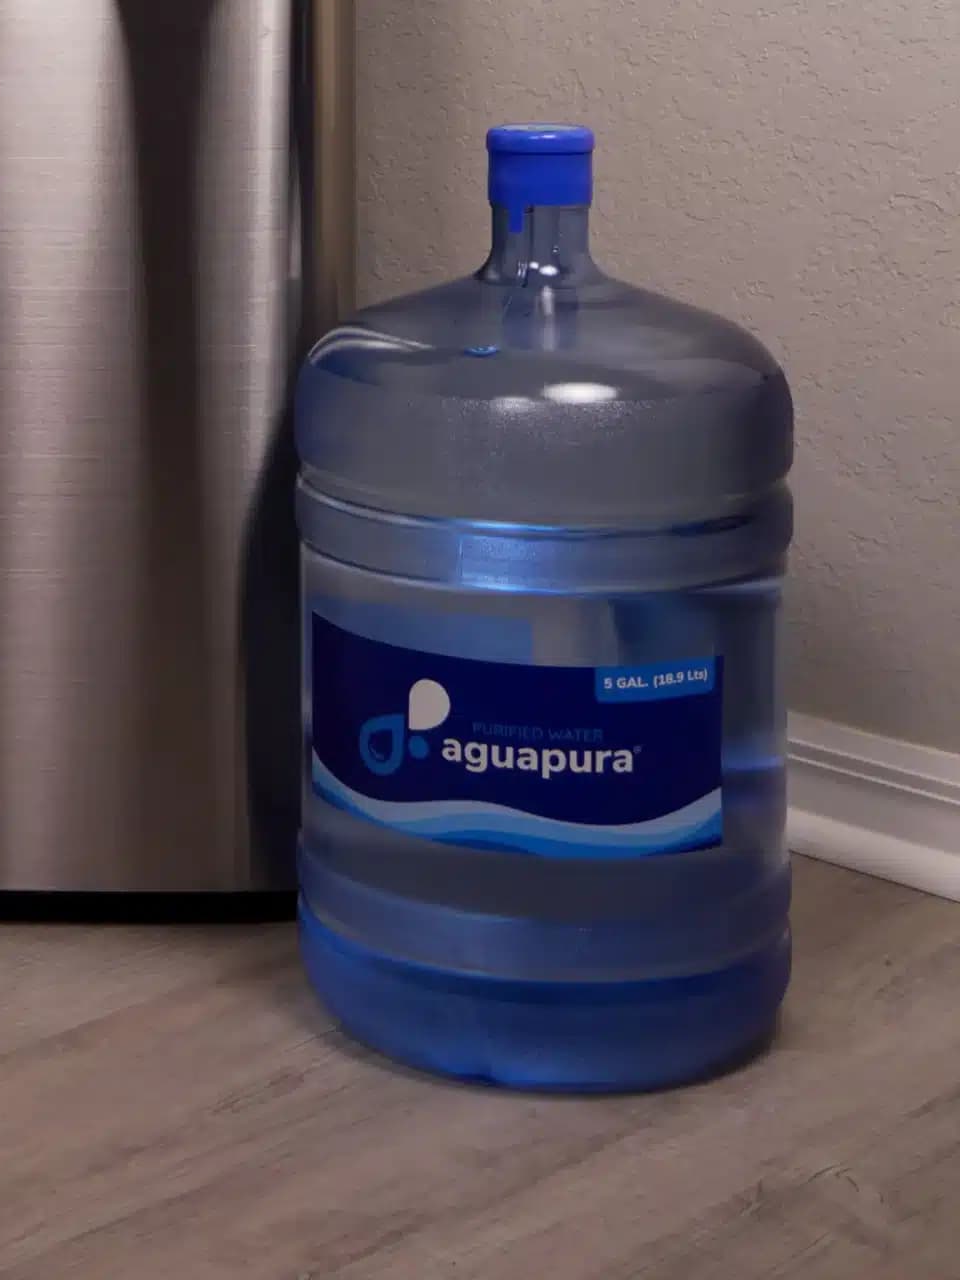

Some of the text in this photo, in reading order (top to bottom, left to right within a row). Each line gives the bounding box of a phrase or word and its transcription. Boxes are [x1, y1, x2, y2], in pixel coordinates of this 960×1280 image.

[603, 677, 613, 689] 5
[616, 676, 649, 689] GAL.
[653, 671, 685, 689] (18.9
[472, 722, 605, 743] PURIFIED WATER
[441, 737, 634, 780] aguapura
